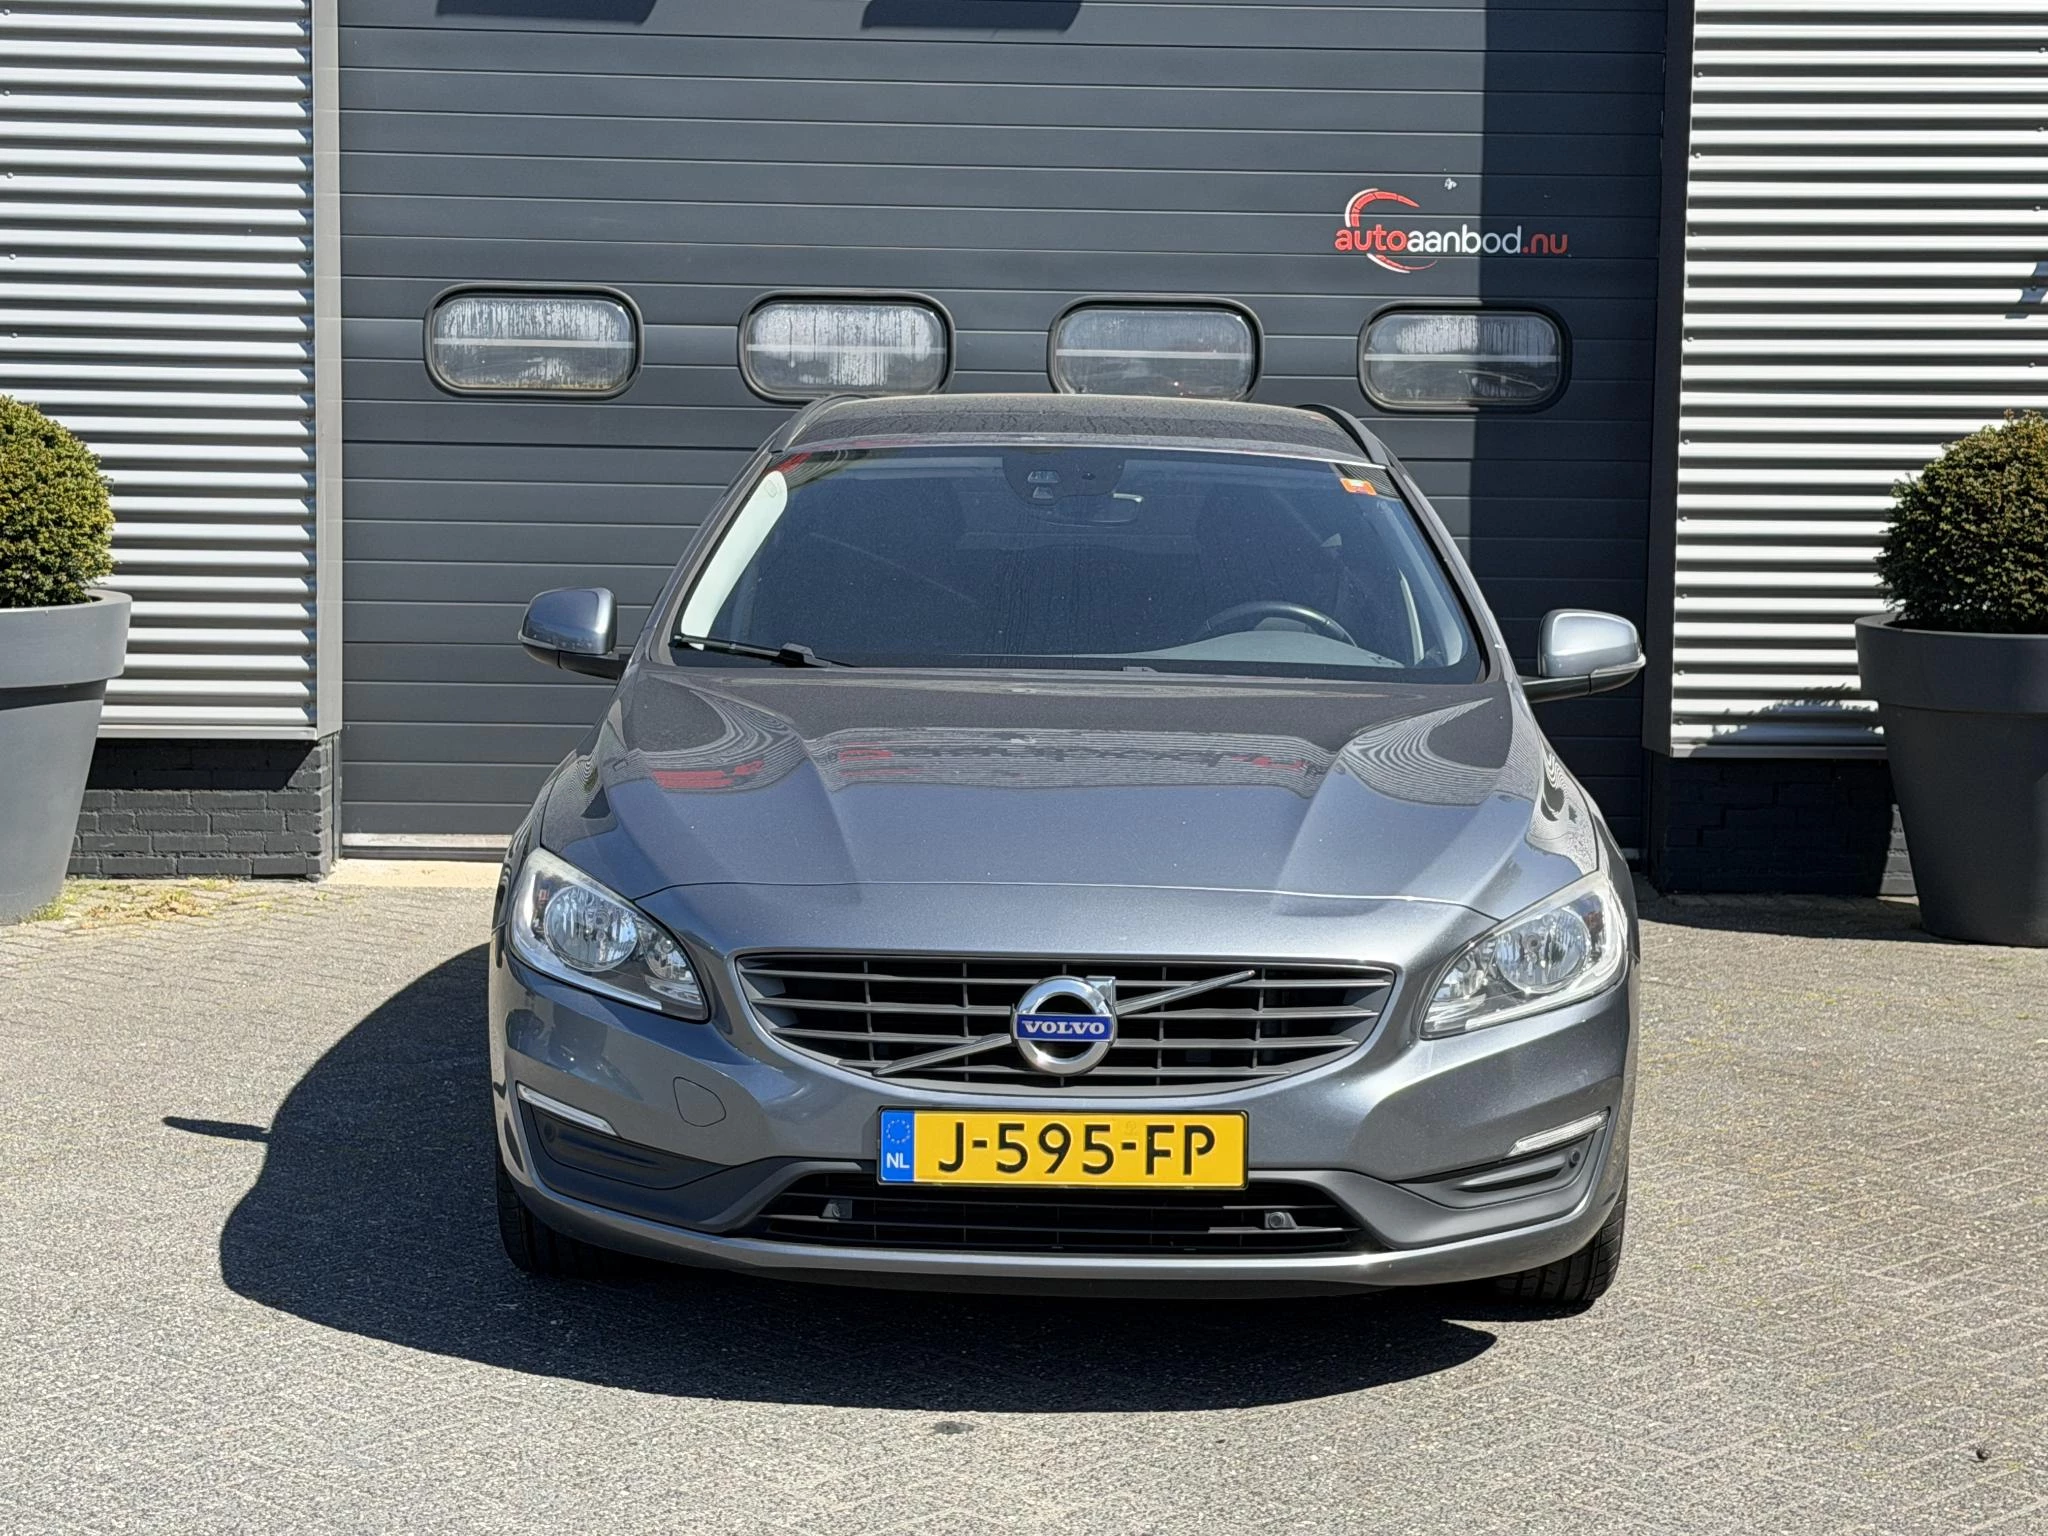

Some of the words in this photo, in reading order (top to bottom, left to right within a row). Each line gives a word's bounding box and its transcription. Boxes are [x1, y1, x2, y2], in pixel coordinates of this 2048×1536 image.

[1334, 223, 1568, 254] autoaanbod.nu
[1022, 1020, 1105, 1035] VOLVO
[886, 1152, 910, 1169] NL
[938, 1121, 1216, 1176] J-595-FP
